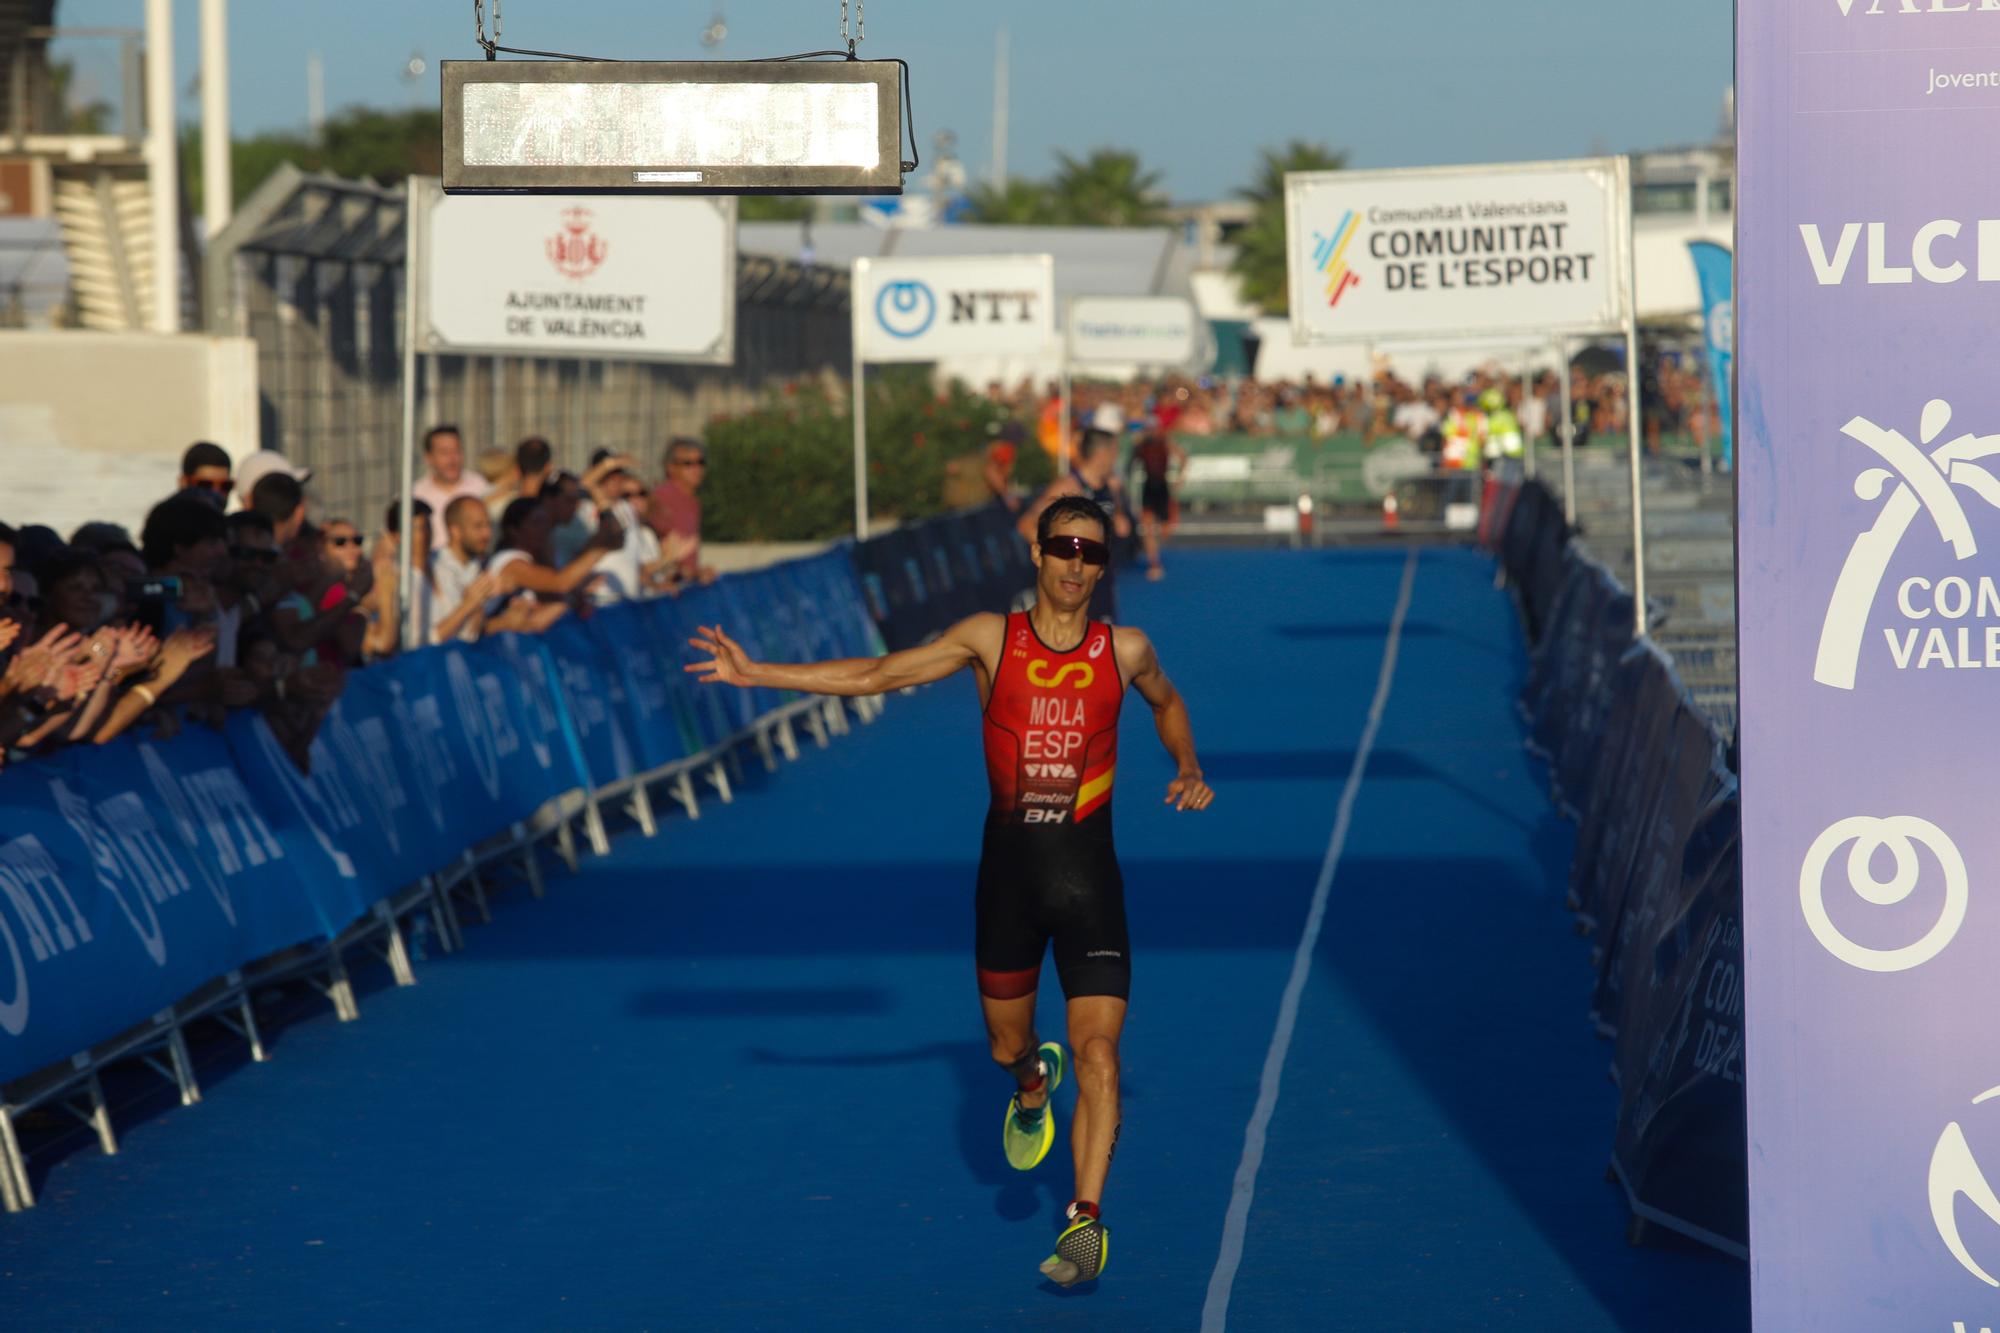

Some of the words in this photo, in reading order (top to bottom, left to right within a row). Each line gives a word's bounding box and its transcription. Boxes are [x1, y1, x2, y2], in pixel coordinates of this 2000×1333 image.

[1926, 67, 2000, 94] Jovent
[1368, 206, 1463, 224] Comunitat
[1468, 200, 1568, 218] Valenciana
[1370, 222, 1569, 259] COMUNITAT
[1799, 219, 2000, 285] VLC
[1386, 263, 1428, 291] DE
[1439, 253, 1595, 288] L'ESPORT
[505, 292, 647, 314] AJUNTAMENT
[950, 289, 1037, 322] NTT
[506, 316, 534, 335] DE
[1029, 696, 1085, 727] MOLA
[1024, 730, 1083, 759] ESP
[1024, 763, 1077, 778] VIVA
[1021, 791, 1075, 804] Santini
[1023, 808, 1067, 823] BH
